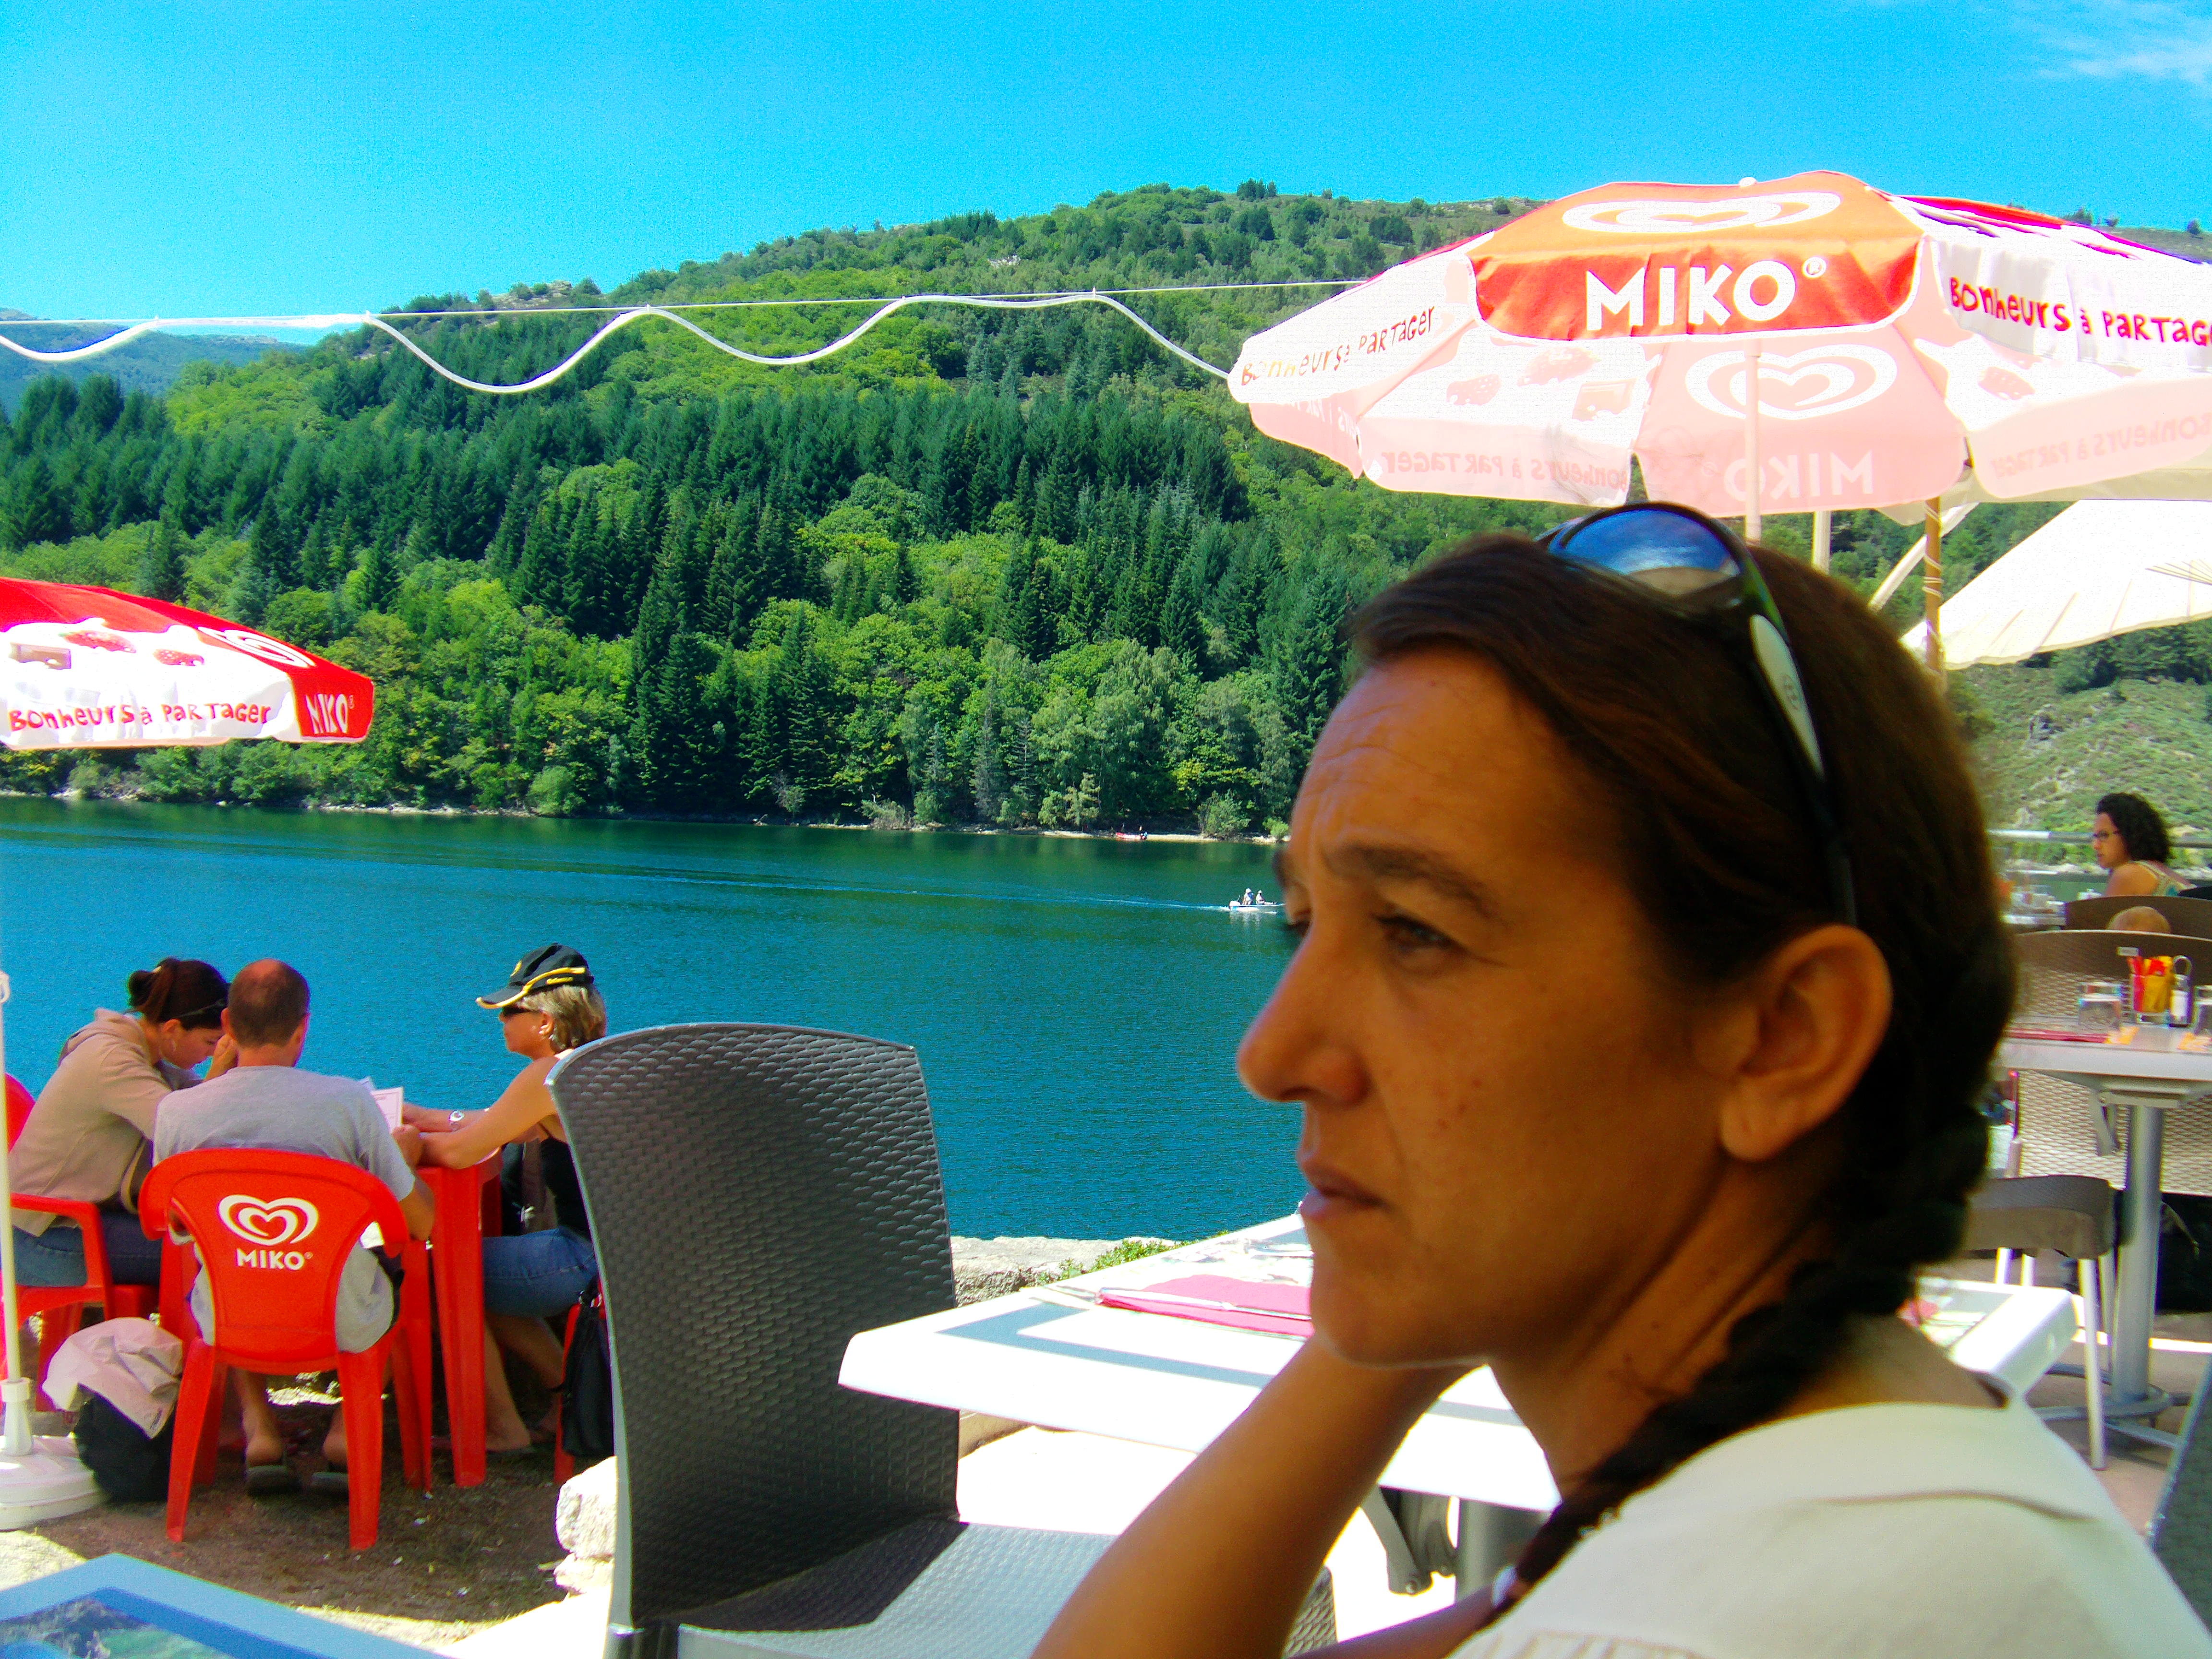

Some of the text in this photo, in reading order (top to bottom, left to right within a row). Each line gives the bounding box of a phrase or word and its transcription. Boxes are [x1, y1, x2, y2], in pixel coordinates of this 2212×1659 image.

[2080, 308, 2092, 335] à
[2102, 311, 2212, 347] PaRTaG
[8, 705, 135, 732] Bonheurs
[140, 708, 153, 725] à
